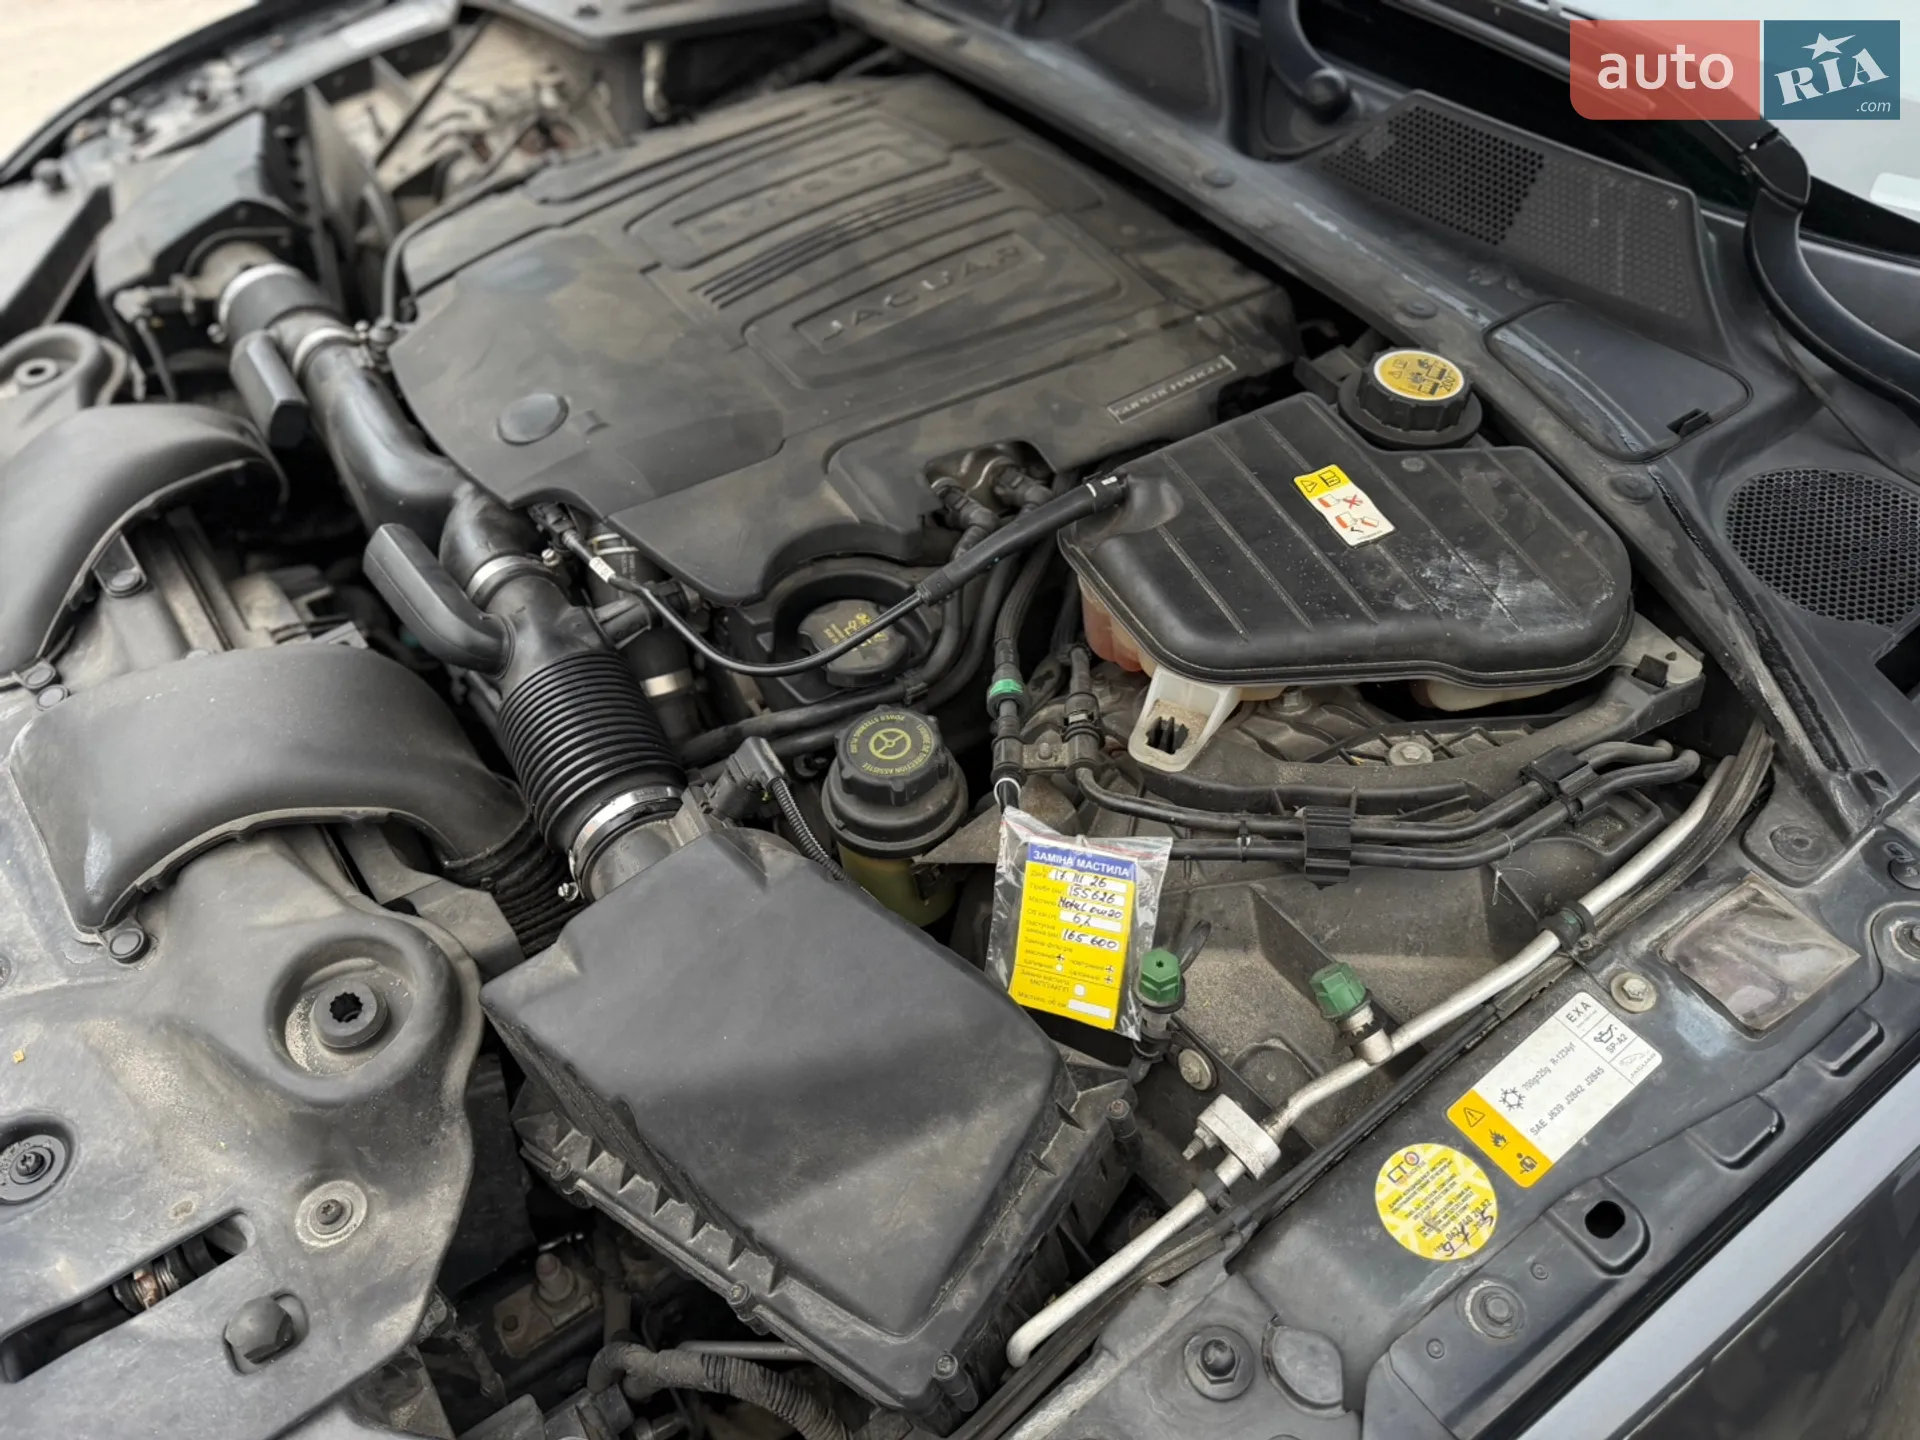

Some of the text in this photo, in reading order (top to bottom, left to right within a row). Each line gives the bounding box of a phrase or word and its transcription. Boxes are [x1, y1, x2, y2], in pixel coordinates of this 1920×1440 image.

[1033, 850, 1130, 877] ЗАМІНА МАСТИЛА
[1565, 1001, 1592, 1023] EXA
[1605, 1033, 1629, 1054] SP-A2
[1529, 1118, 1548, 1137] SAE
[1547, 1103, 1566, 1122] J639
